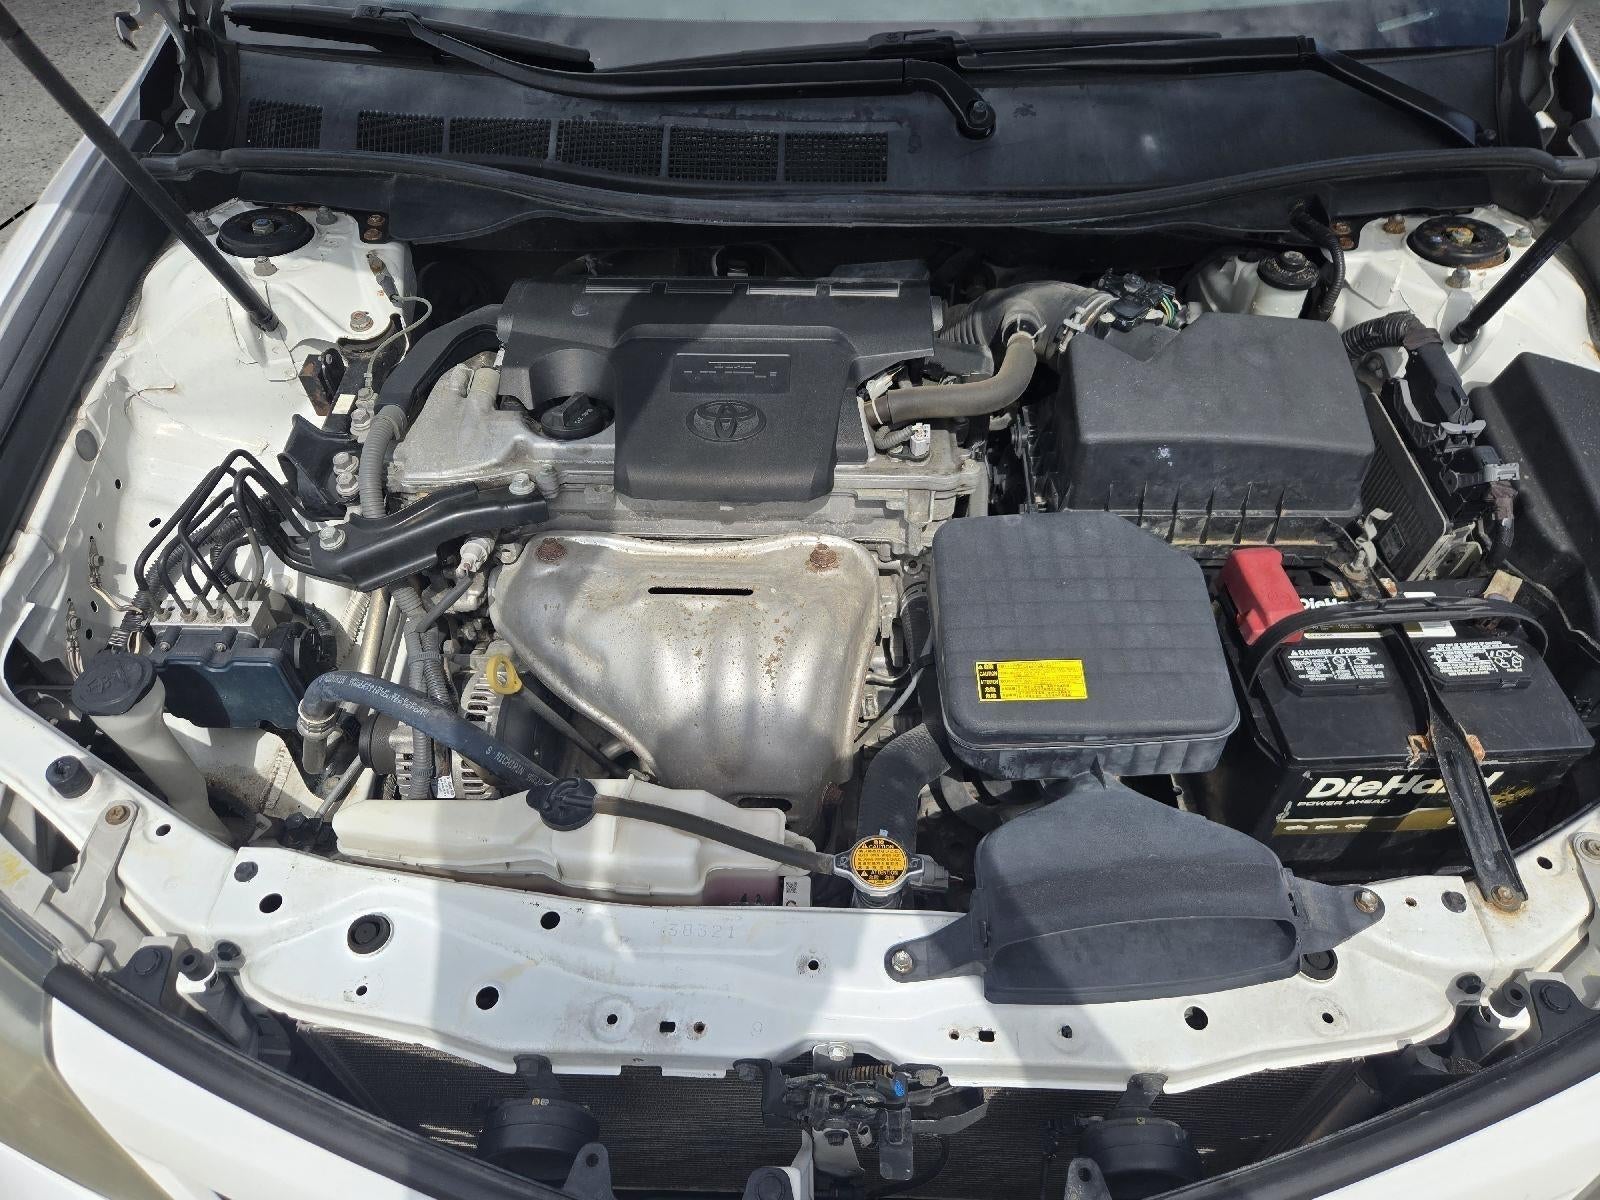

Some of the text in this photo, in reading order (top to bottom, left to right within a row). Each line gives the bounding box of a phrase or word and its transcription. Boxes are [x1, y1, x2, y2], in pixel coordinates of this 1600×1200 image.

[1298, 648, 1332, 656] DANGER
[1339, 647, 1371, 655] POISON
[1345, 798, 1391, 806] AHEAD
